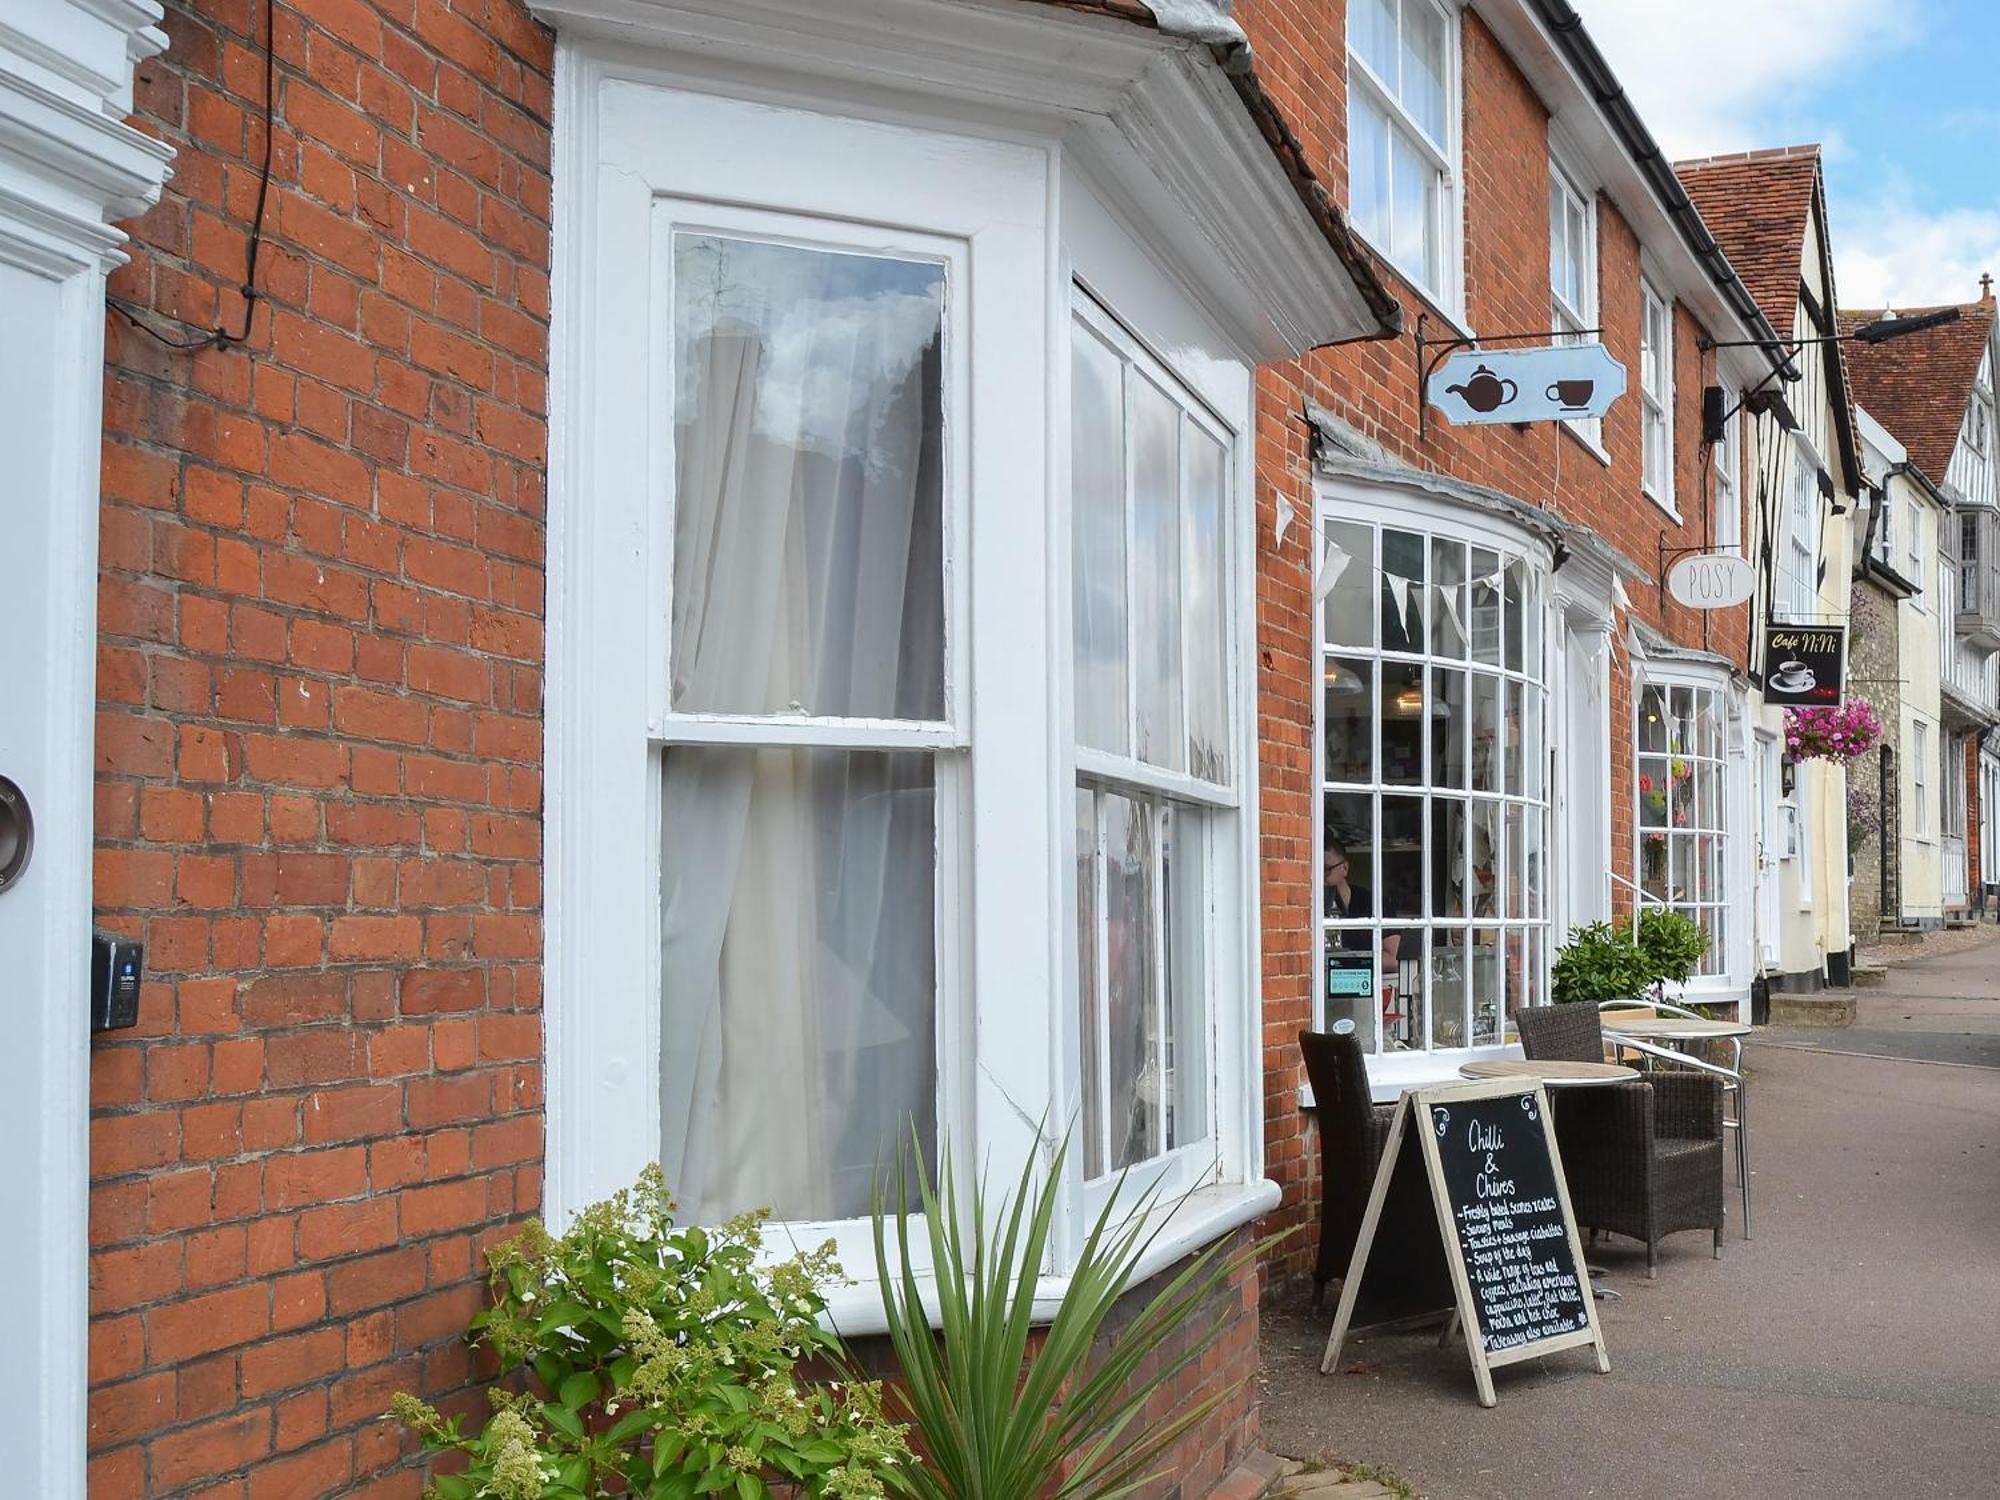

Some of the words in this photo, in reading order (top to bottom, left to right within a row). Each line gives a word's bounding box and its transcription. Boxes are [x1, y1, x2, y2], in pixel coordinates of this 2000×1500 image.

[1689, 563, 1736, 600] POSY
[1771, 633, 1799, 650] Café
[1802, 632, 1837, 653] NiNi
[1468, 1118, 1505, 1152] Chilli
[1485, 1152, 1500, 1174] &
[1476, 1172, 1516, 1199] Chives
[1473, 1251, 1493, 1266] Soup
[1493, 1249, 1502, 1265] of
[1501, 1246, 1516, 1260] the
[1517, 1244, 1532, 1260] day
[1526, 1326, 1540, 1339] also
[1542, 1319, 1575, 1335] available
